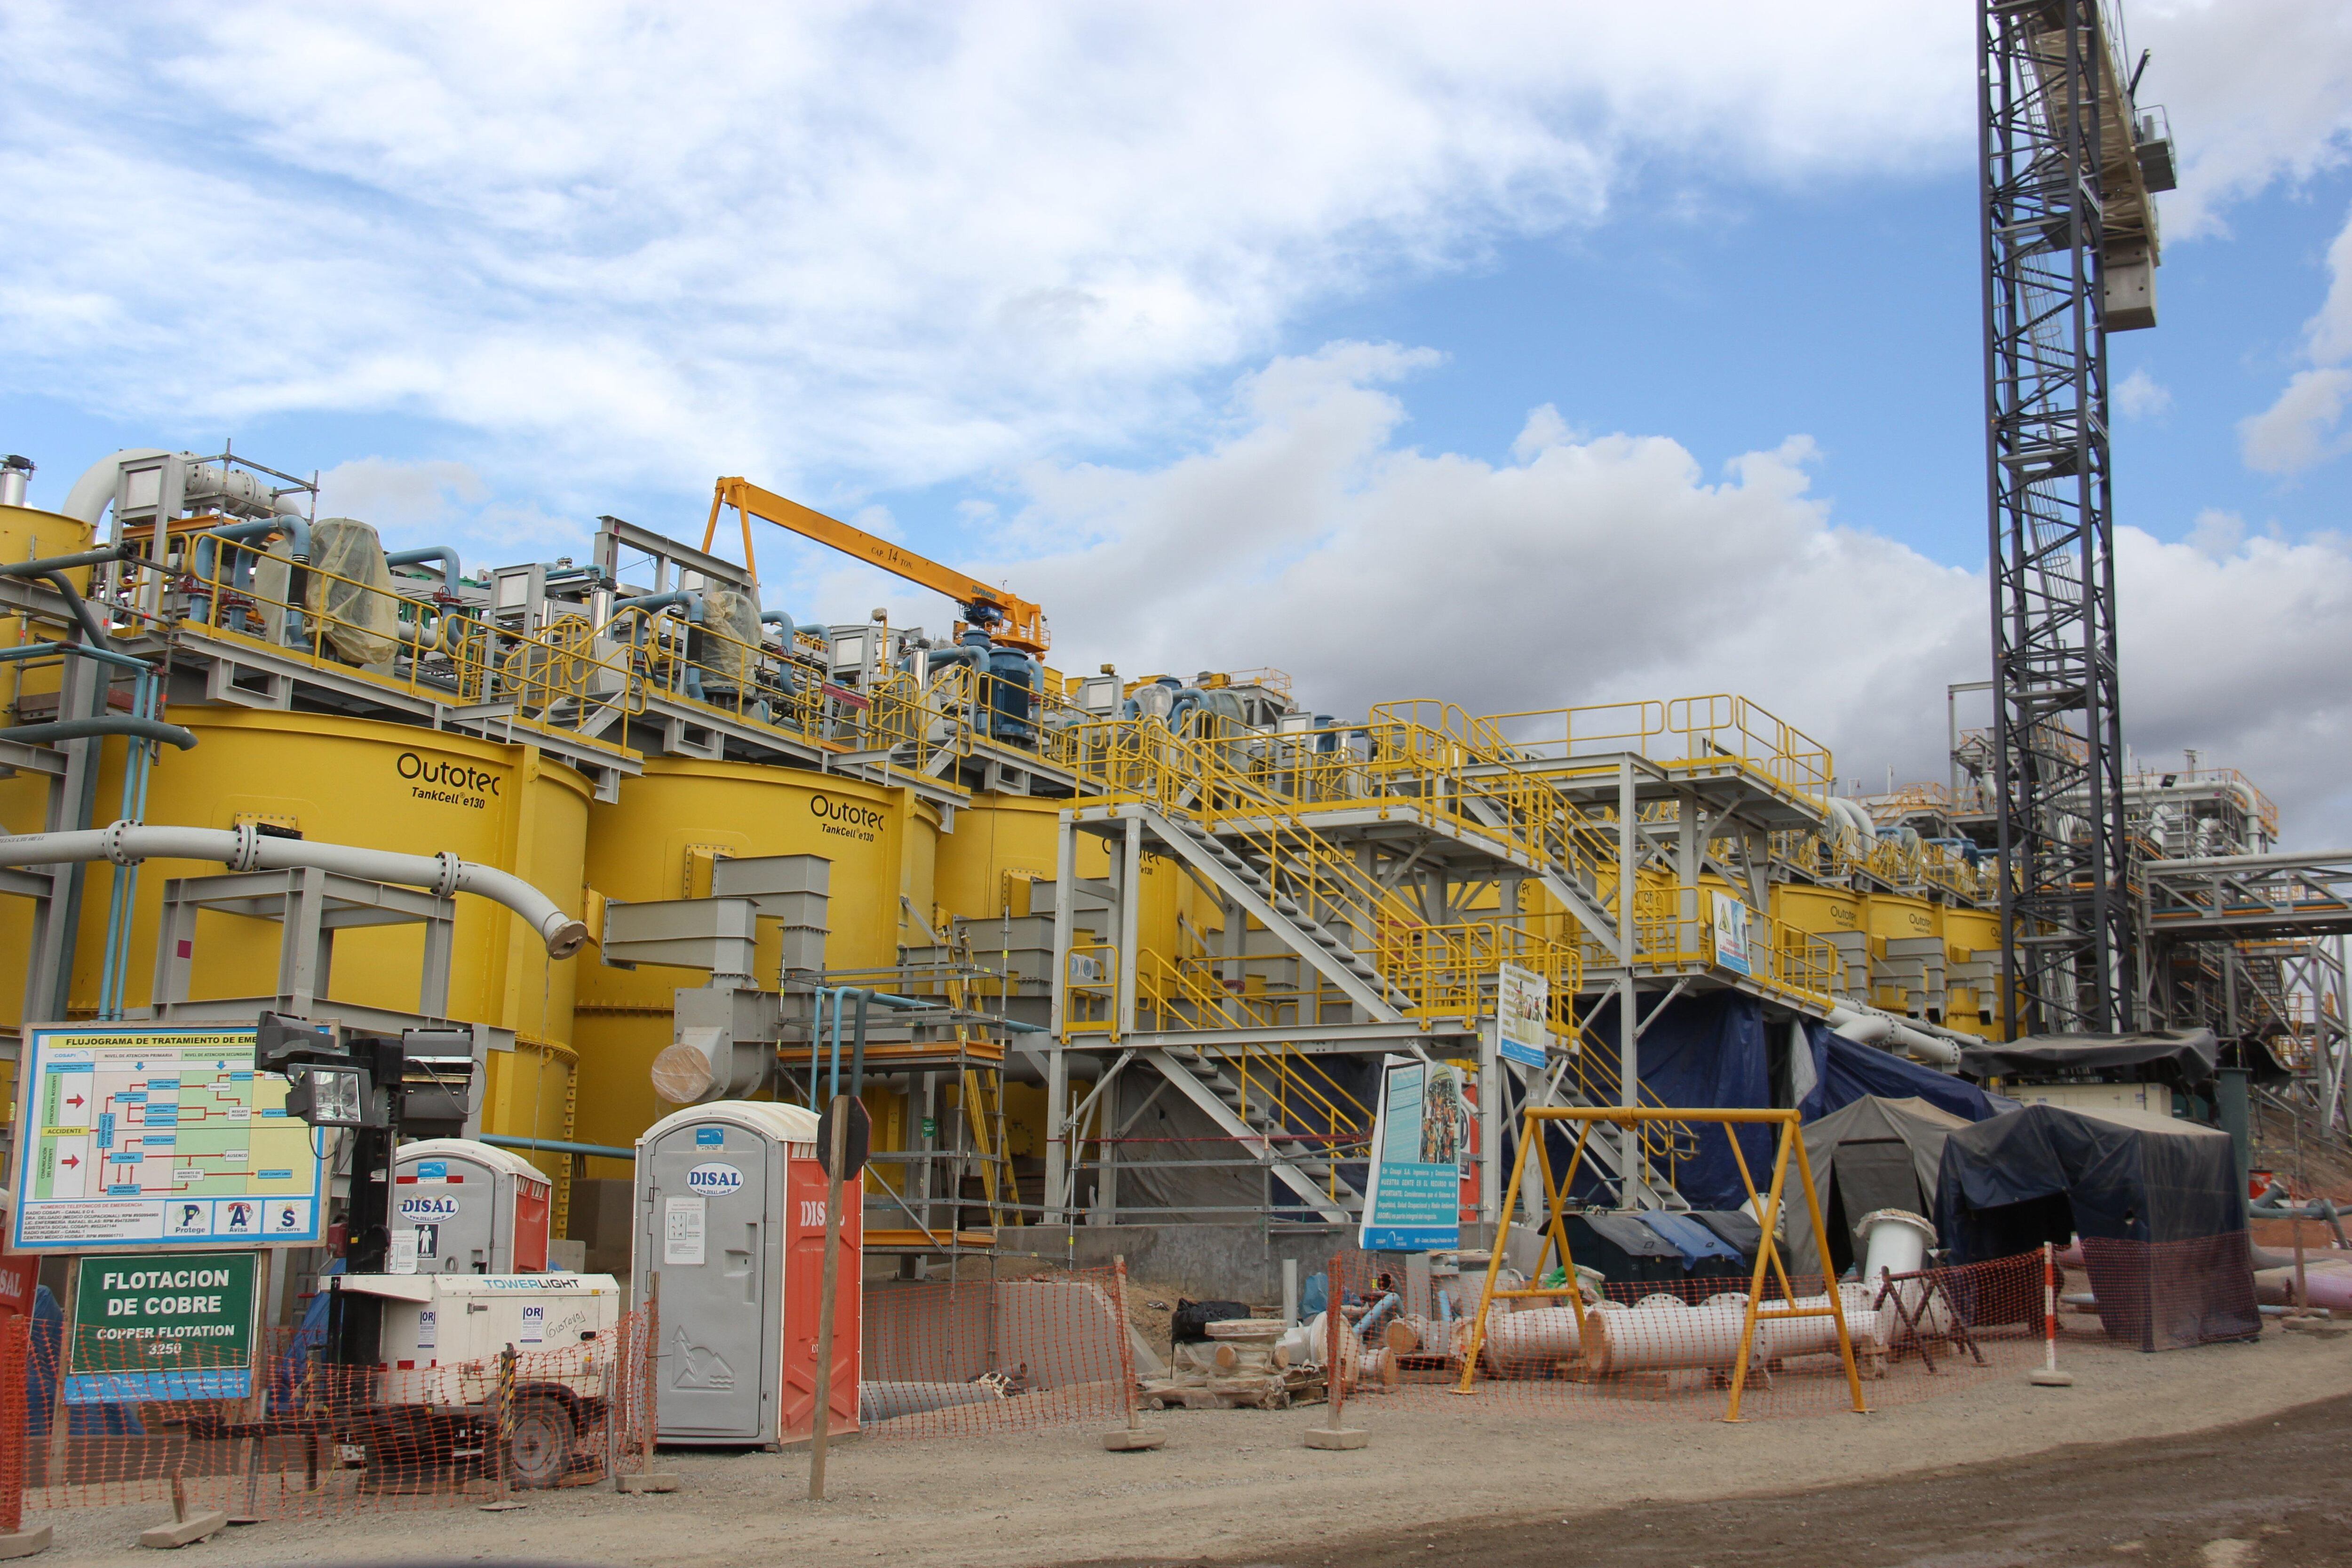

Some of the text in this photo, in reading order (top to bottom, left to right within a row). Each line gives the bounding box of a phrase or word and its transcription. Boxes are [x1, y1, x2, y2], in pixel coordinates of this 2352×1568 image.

[871, 547, 884, 557] CAP.
[888, 548, 898, 562] 14
[397, 753, 501, 796] Outotec
[463, 797, 485, 809] e130
[810, 795, 884, 831] Outotec
[858, 832, 874, 842] e130
[66, 1037, 133, 1045] FLUJOGRAMA
[690, 1172, 740, 1186] DISAL
[402, 1200, 455, 1213] DISAL
[183, 1204, 200, 1226] P
[230, 1205, 246, 1226] A
[282, 1210, 295, 1226] S
[0, 1269, 22, 1297] SAL
[103, 1269, 230, 1290] FLOTACION
[483, 1279, 580, 1289] TOWERLIGHT
[108, 1295, 222, 1316] DE COBRE
[97, 1325, 235, 1340] COPPER FLOTATION
[149, 1343, 182, 1355] 3250
